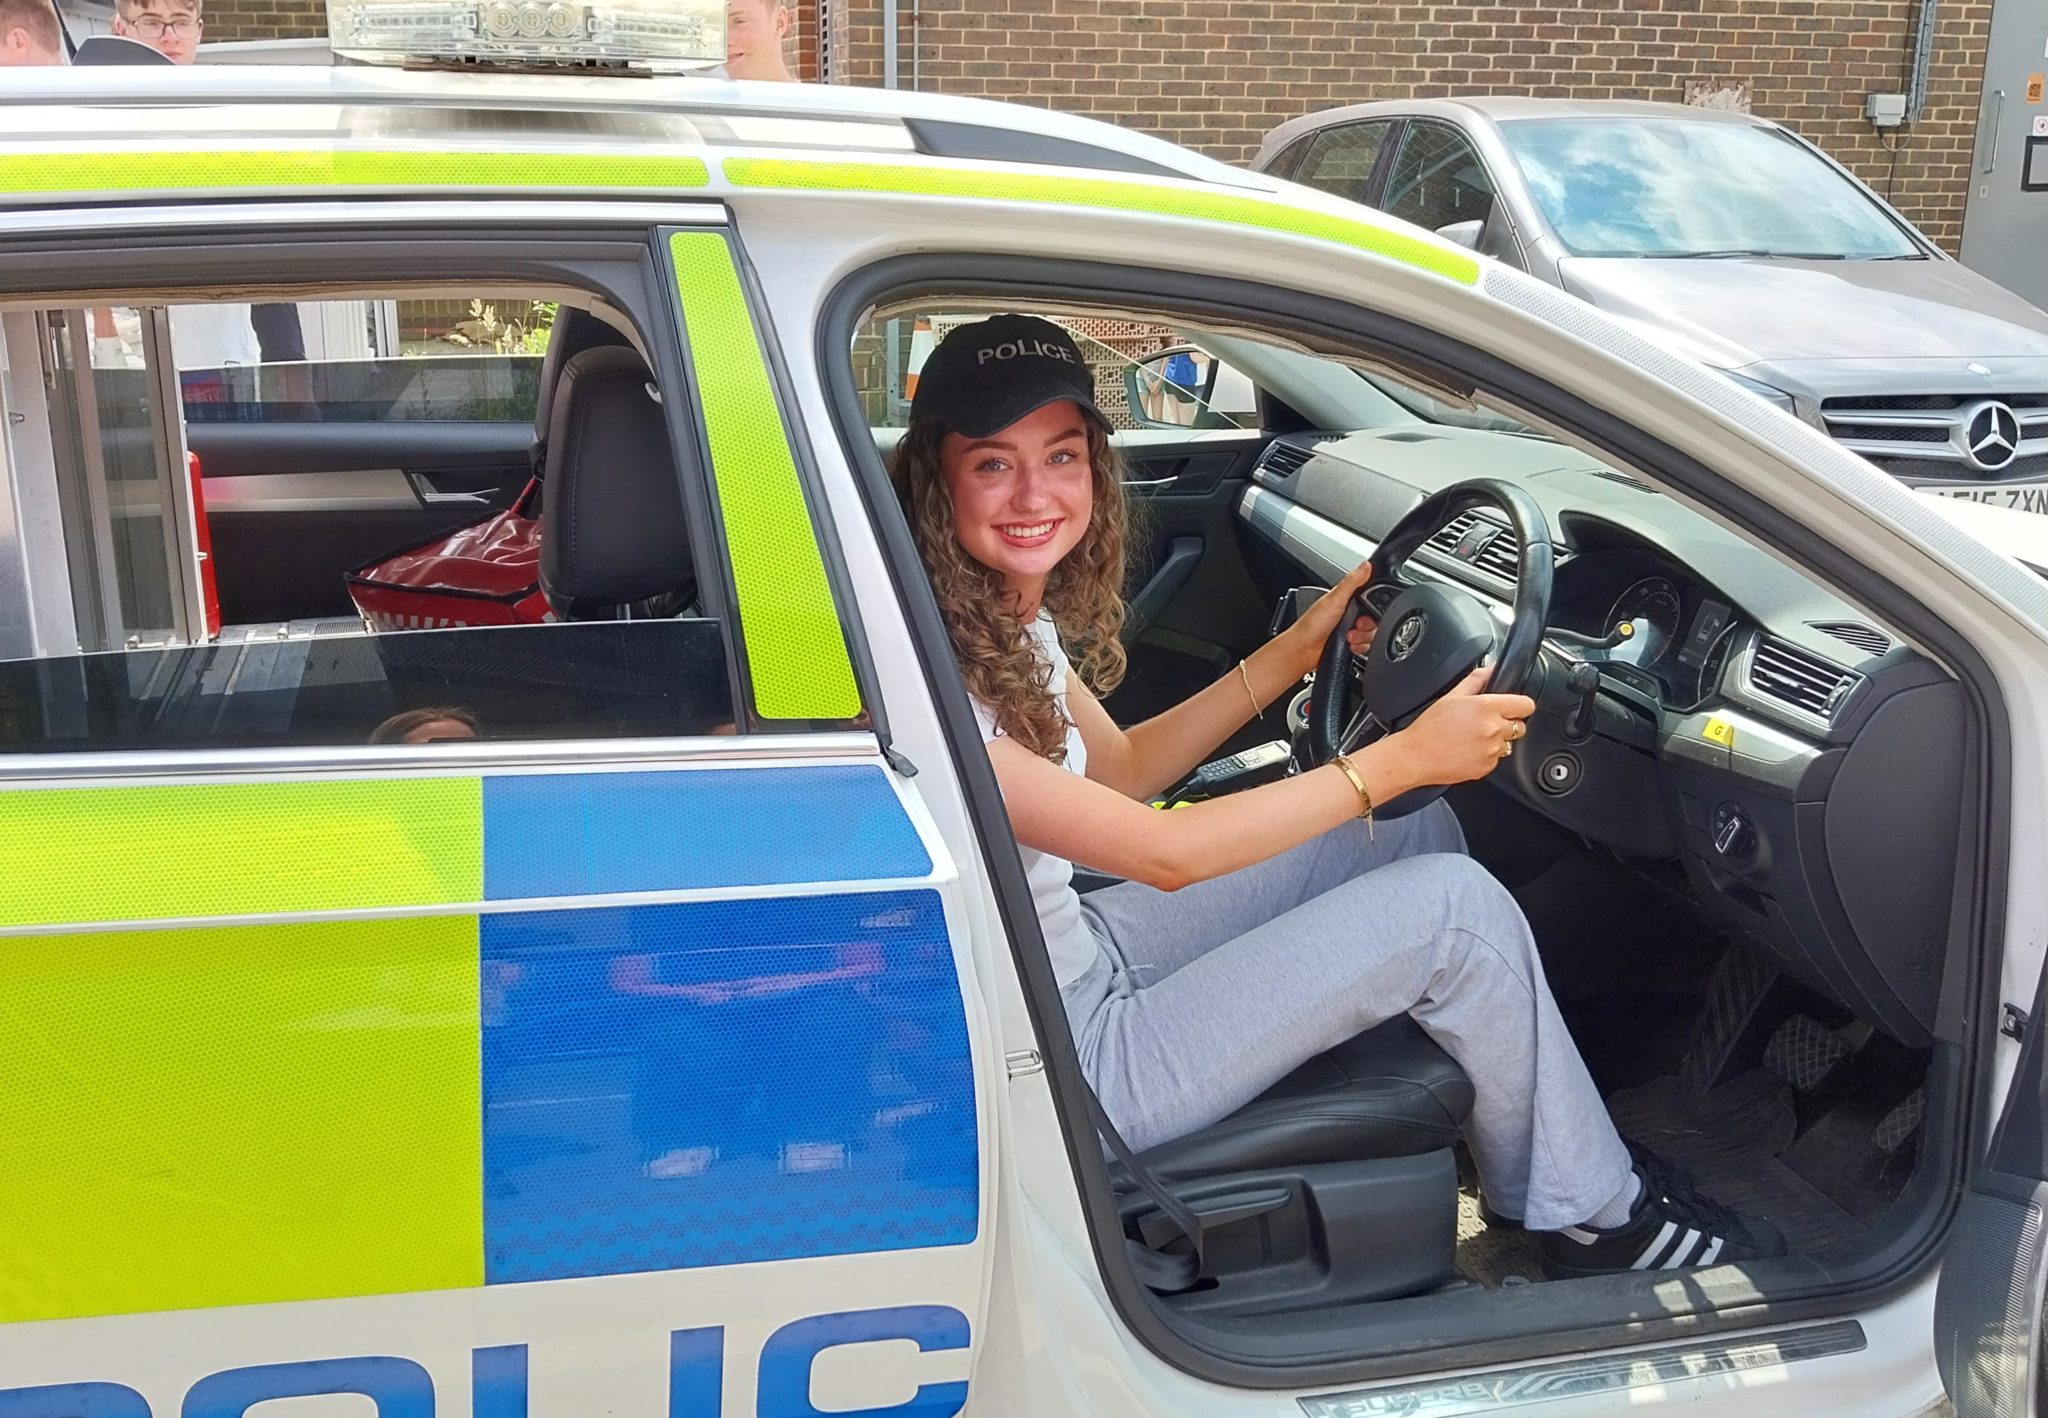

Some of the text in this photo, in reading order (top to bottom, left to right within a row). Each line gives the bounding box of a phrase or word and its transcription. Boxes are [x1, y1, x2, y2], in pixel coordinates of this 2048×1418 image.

[977, 339, 1076, 365] POLICE
[1714, 725, 1723, 736] G
[0, 1304, 971, 1418] LIC
